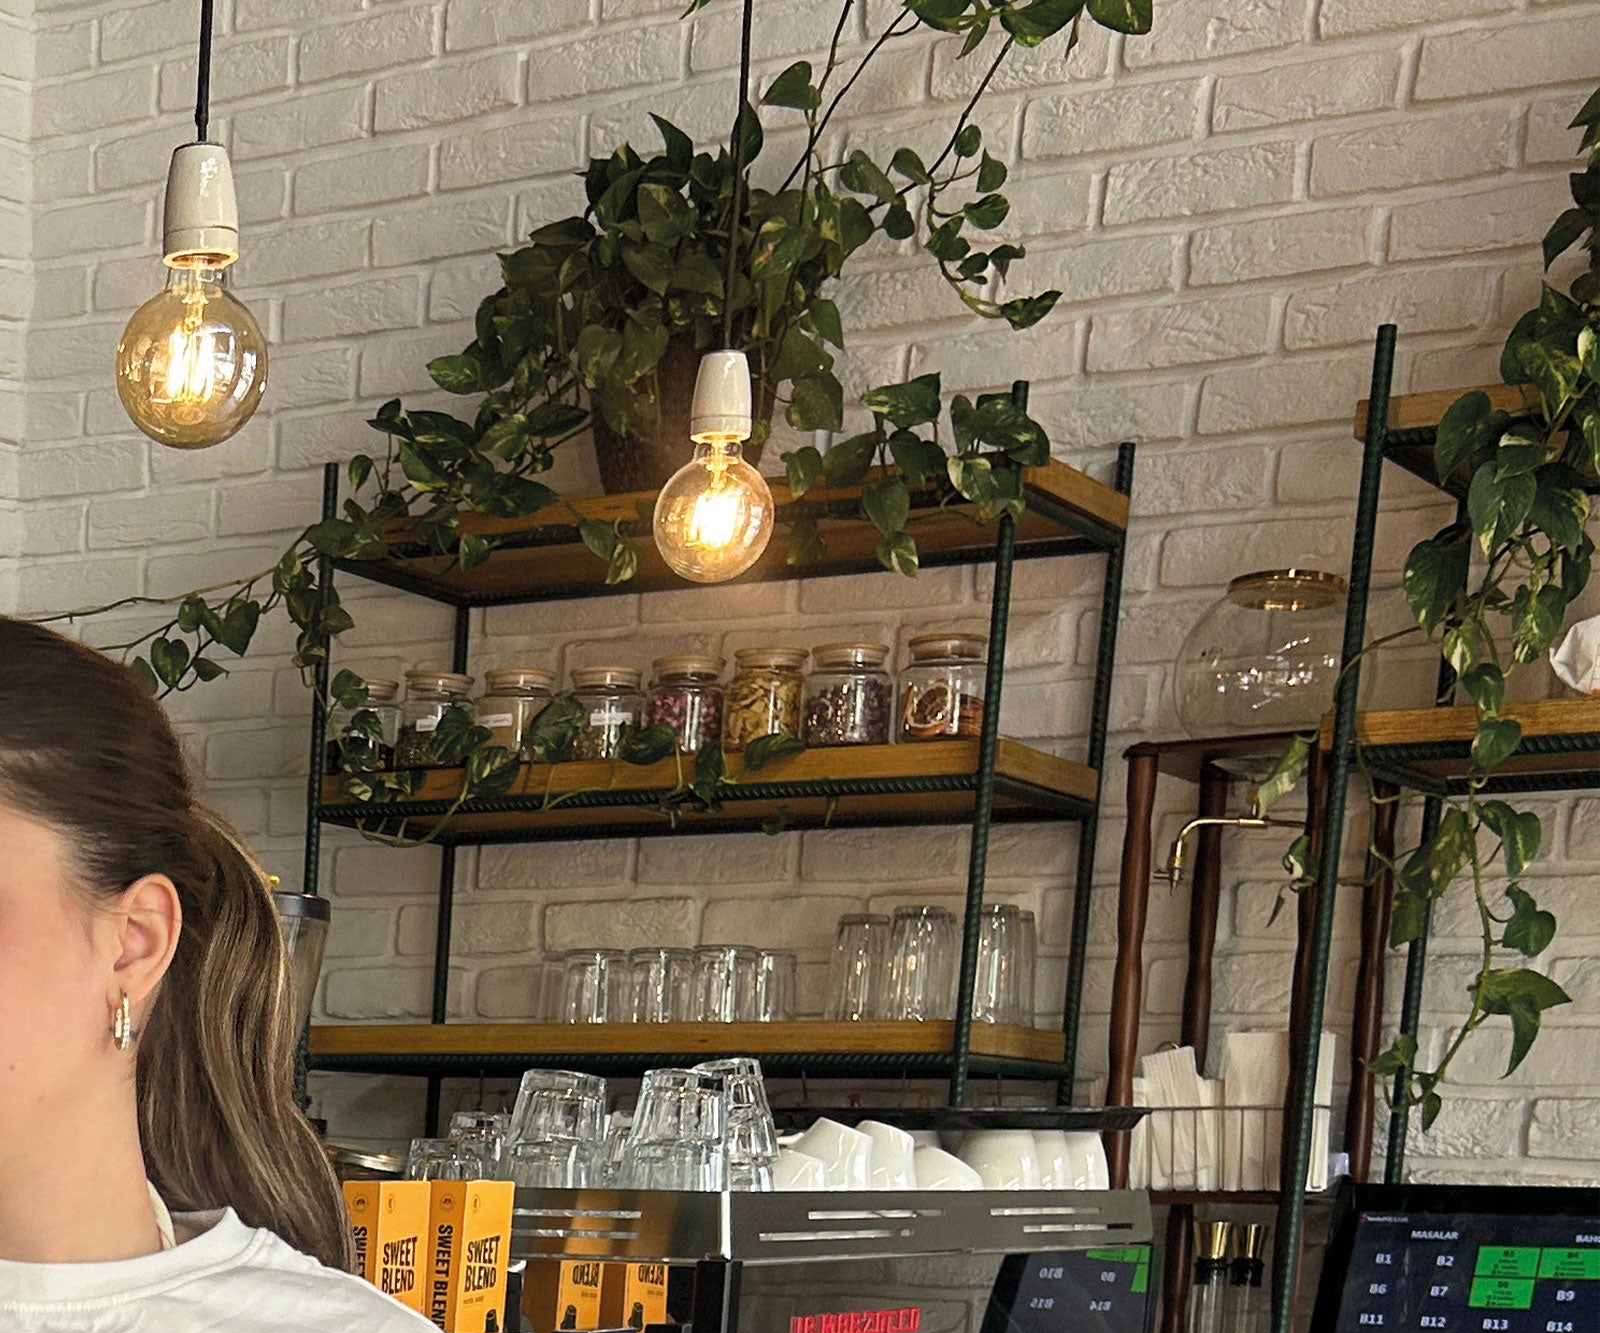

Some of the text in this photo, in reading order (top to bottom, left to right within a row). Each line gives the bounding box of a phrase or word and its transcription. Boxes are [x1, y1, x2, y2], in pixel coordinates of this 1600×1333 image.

[1411, 1230, 1458, 1240] MASALAR
[383, 1236, 418, 1267] SWEET
[435, 1224, 453, 1277] SWEET
[467, 1235, 500, 1266] SWEET
[1375, 1253, 1392, 1265] B1
[1436, 1255, 1454, 1267] B2
[382, 1266, 415, 1294] BLEND
[464, 1265, 497, 1292] BLEND
[1369, 1283, 1387, 1295] B6
[1430, 1286, 1448, 1297] B7
[1556, 1290, 1576, 1301] B9
[1359, 1314, 1573, 1333] B11 B12 B13 B14
